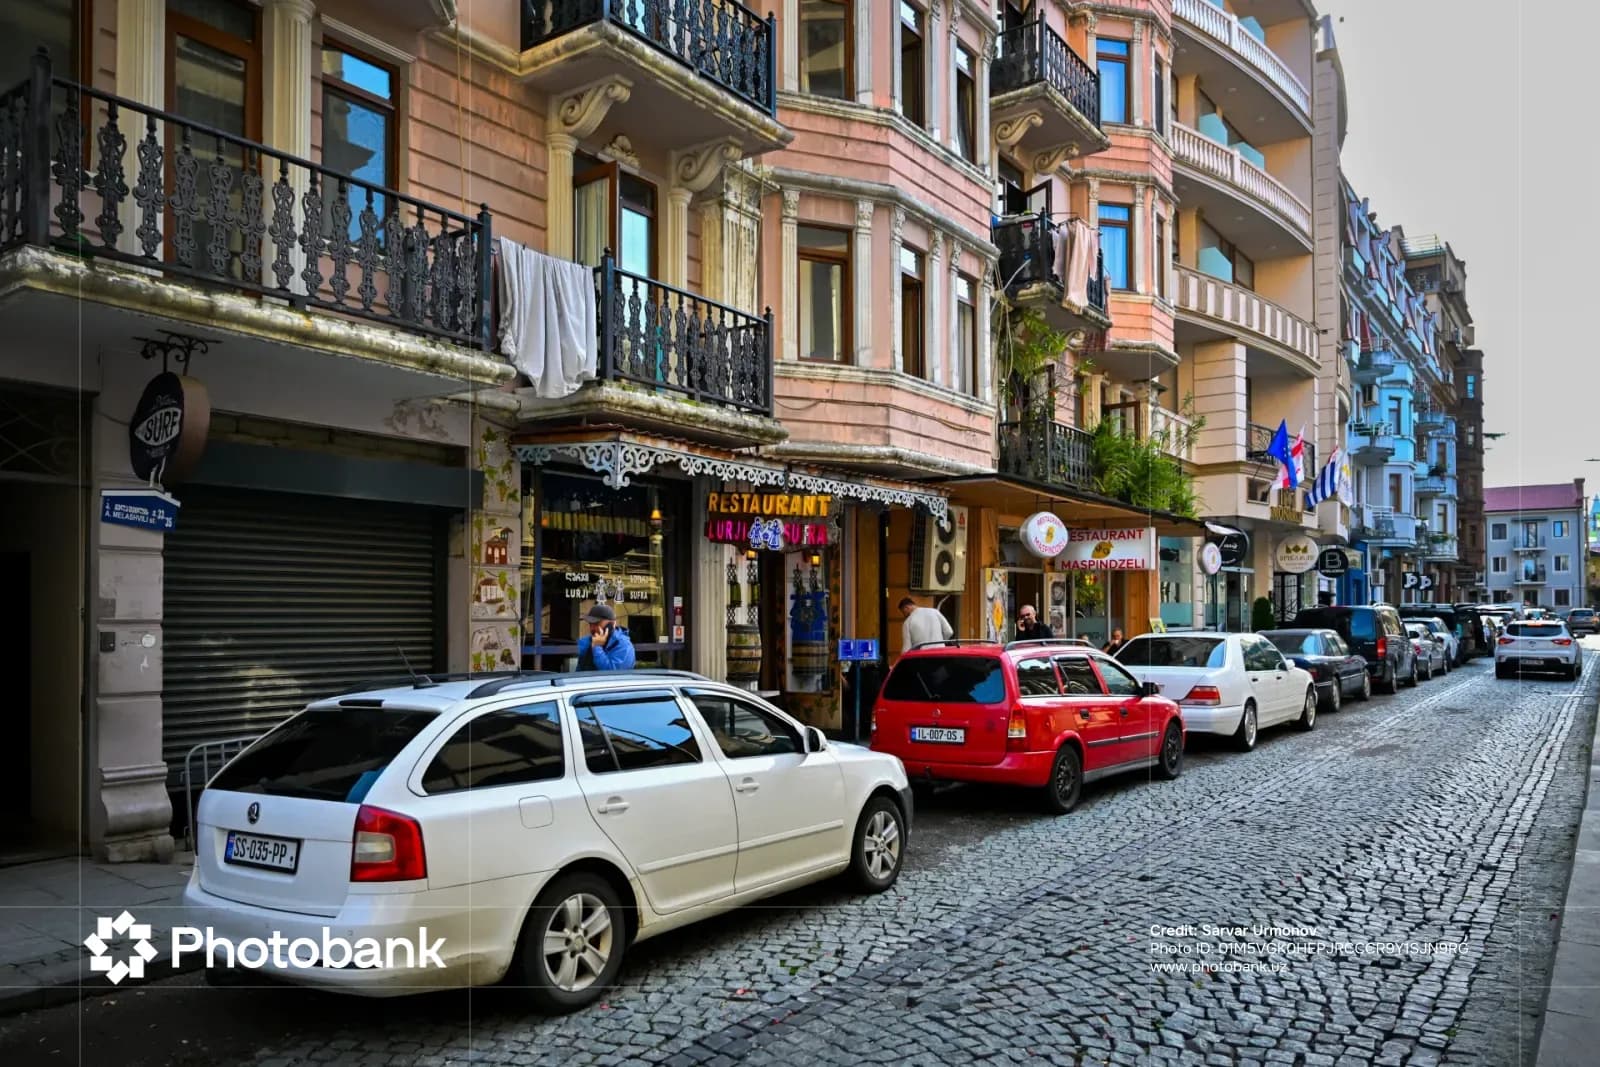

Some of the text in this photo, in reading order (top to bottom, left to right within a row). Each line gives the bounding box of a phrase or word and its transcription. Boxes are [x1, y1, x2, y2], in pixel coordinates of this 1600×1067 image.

[144, 411, 179, 442] SURF
[708, 492, 831, 517] RESTAURANT
[708, 521, 828, 545] LURJI SUFRA
[1068, 529, 1144, 541] ESTAURANT
[1061, 558, 1145, 570] MASPINDZELI
[565, 588, 648, 600] LURJI SUFRA
[233, 837, 288, 865] SS-035-PP
